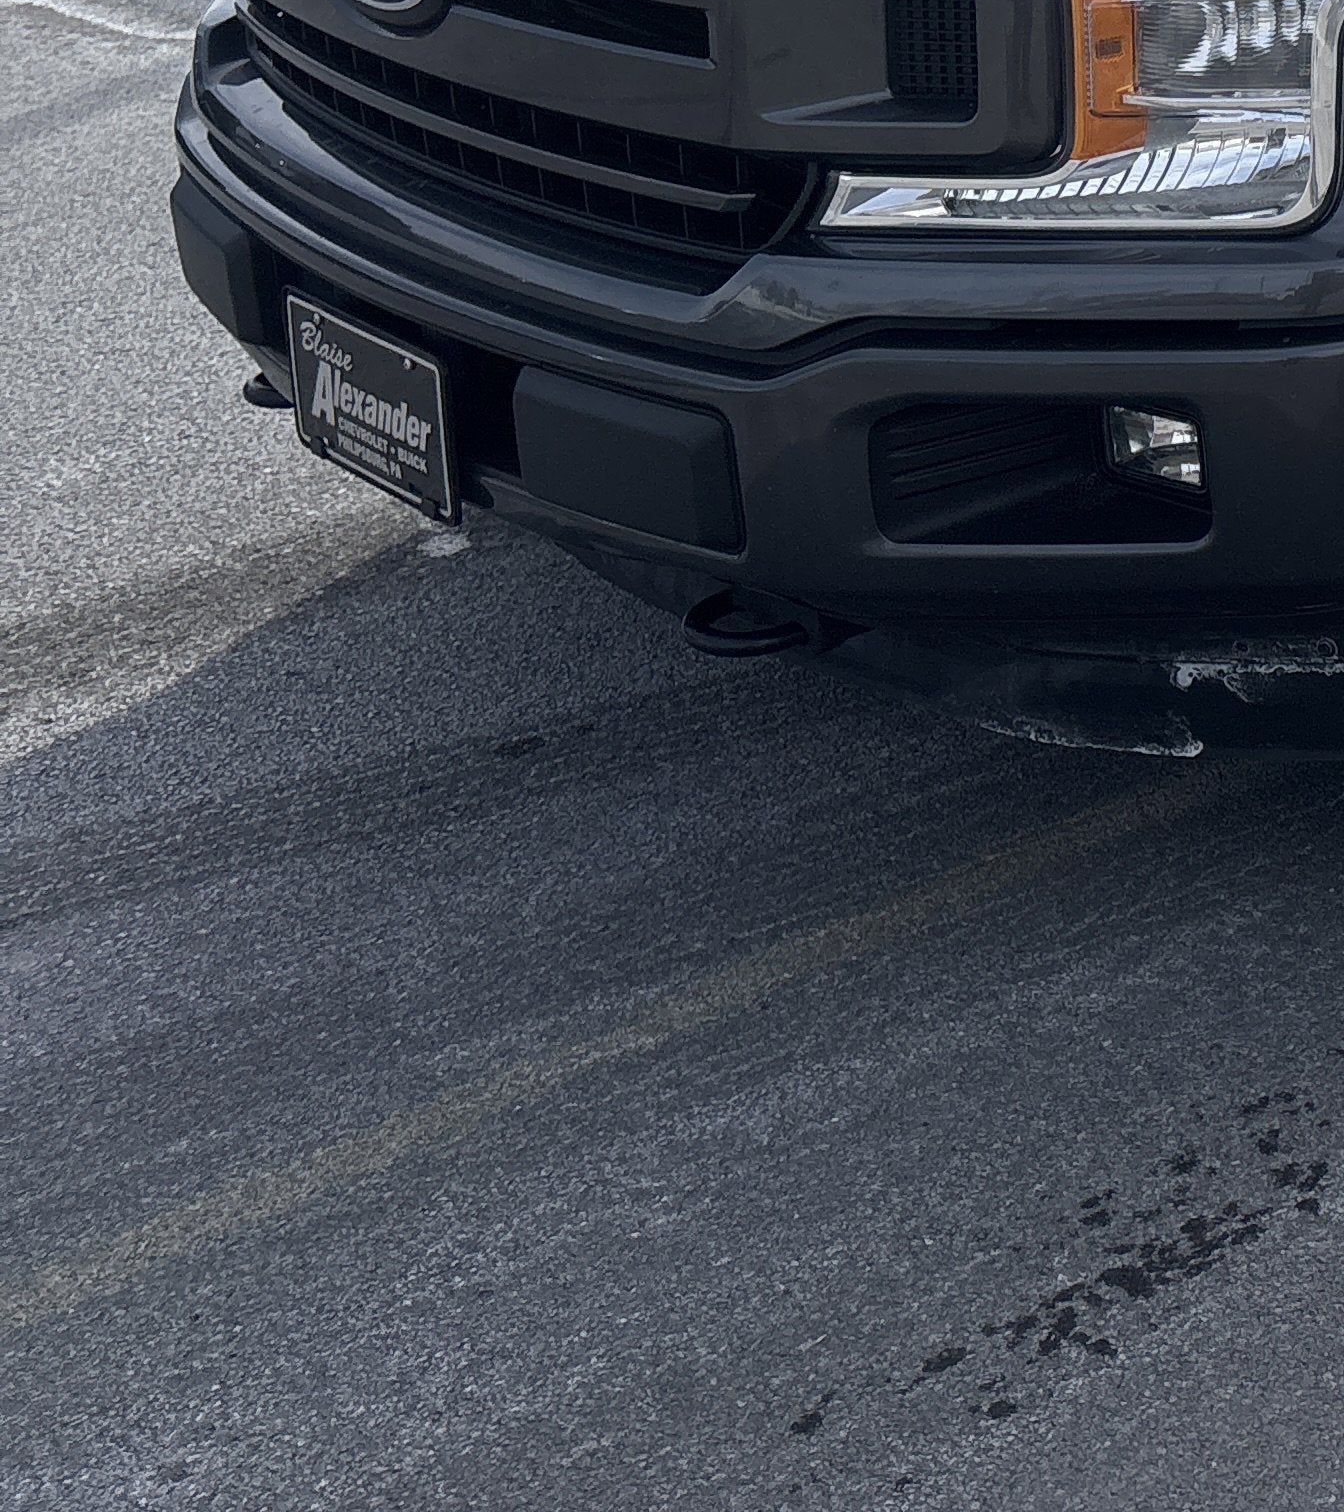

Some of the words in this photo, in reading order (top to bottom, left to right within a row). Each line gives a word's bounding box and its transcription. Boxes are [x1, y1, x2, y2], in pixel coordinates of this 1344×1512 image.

[299, 319, 354, 372] Blaise
[311, 360, 432, 453] Alexander
[337, 416, 388, 454] CHEVROLET
[397, 446, 428, 474] BUICK
